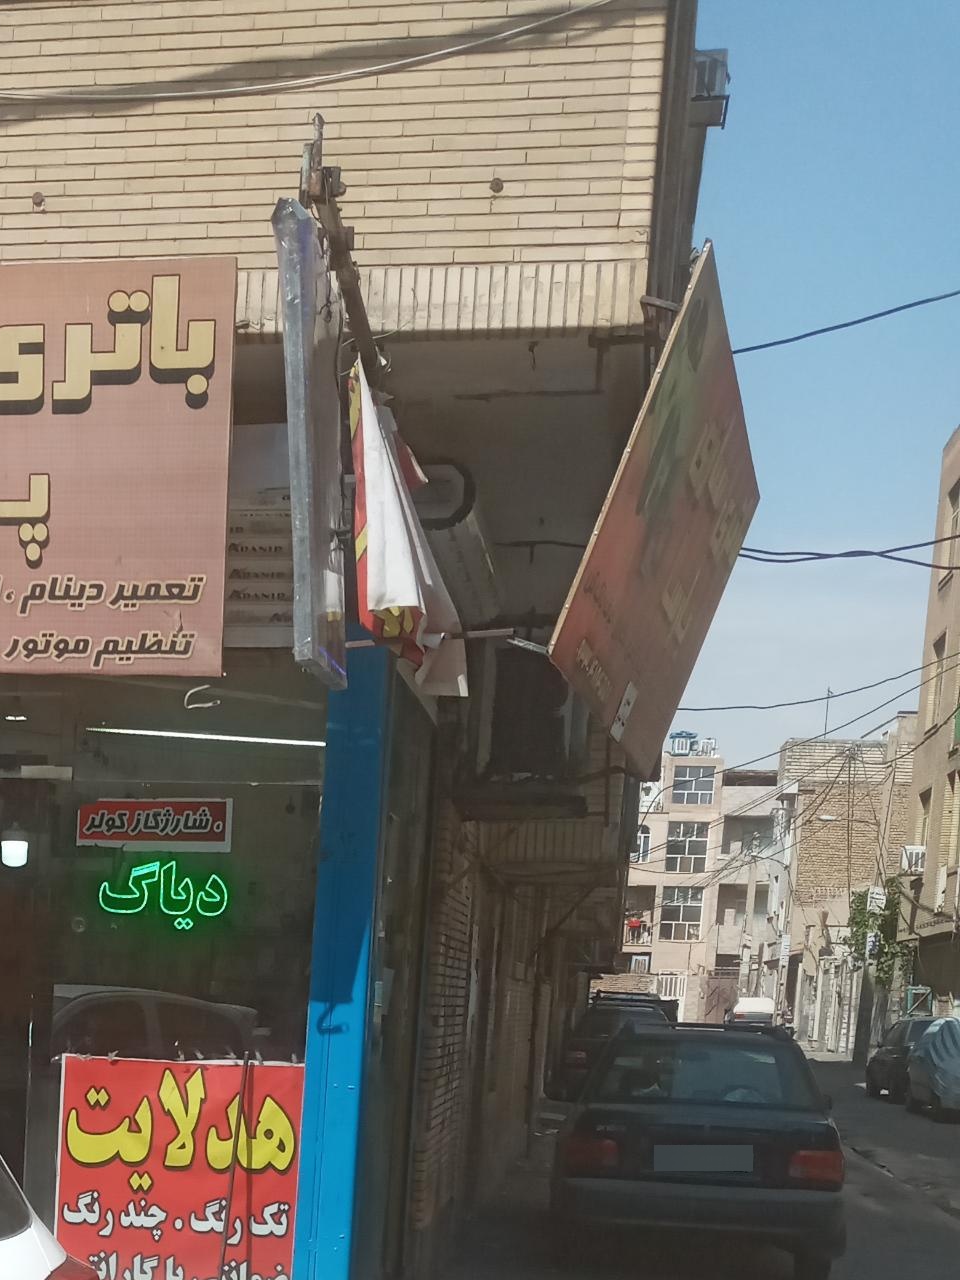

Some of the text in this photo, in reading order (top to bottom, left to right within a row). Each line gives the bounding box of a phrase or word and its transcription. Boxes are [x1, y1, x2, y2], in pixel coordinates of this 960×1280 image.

[17, 575, 106, 616] دینام
[107, 575, 206, 609] تعمیر
[2, 632, 91, 663] موتور
[90, 631, 197, 669] تنظیم
[83, 810, 128, 835] کولر
[99, 861, 228, 930] دیاگ
[62, 1190, 114, 1237] رنگ
[120, 1200, 167, 1241] چند
[190, 1198, 242, 1245] رنگ
[249, 1201, 289, 1236] تک
